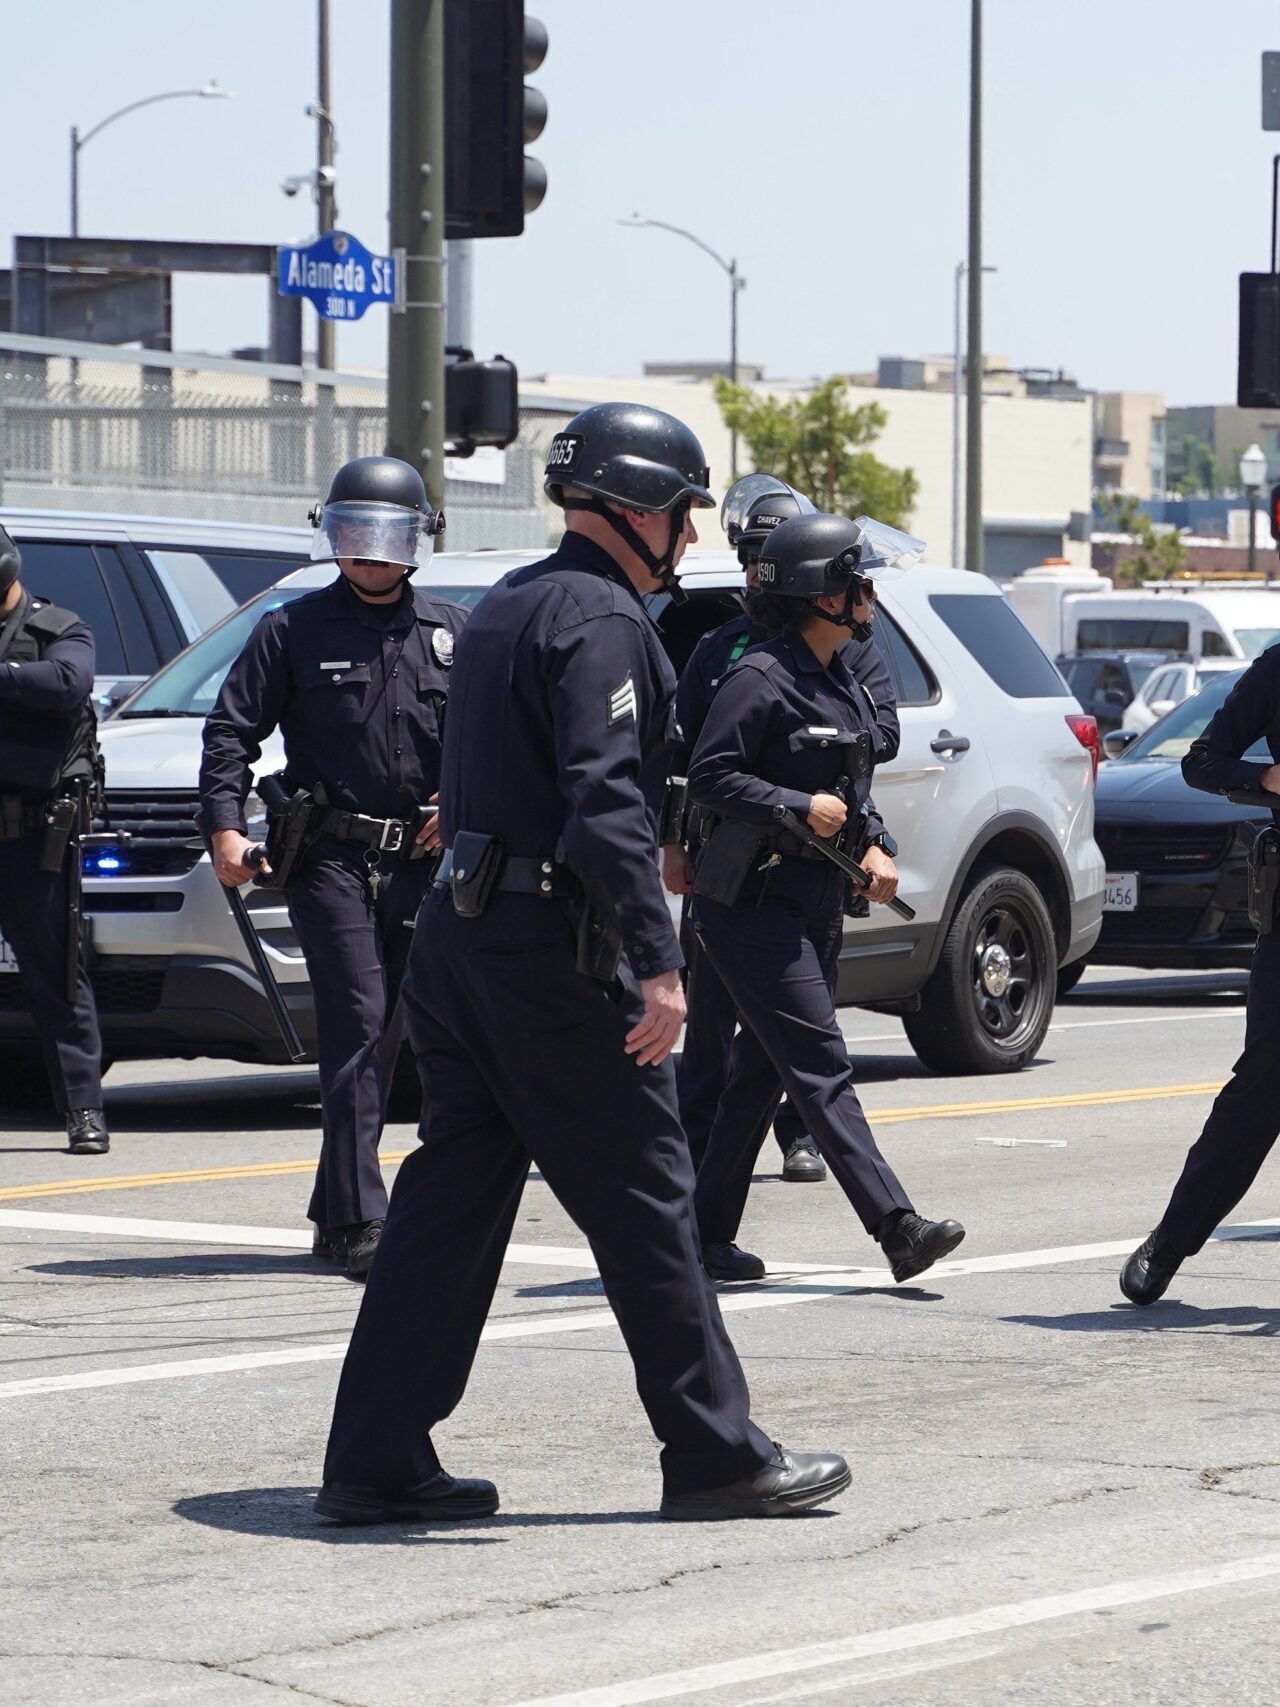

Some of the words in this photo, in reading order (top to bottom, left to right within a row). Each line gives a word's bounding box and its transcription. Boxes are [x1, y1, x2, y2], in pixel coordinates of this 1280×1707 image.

[288, 251, 365, 293] Alameda
[372, 258, 392, 294] St
[326, 296, 346, 317] 300
[347, 299, 356, 317] N
[757, 515, 781, 526] CHAVEZ
